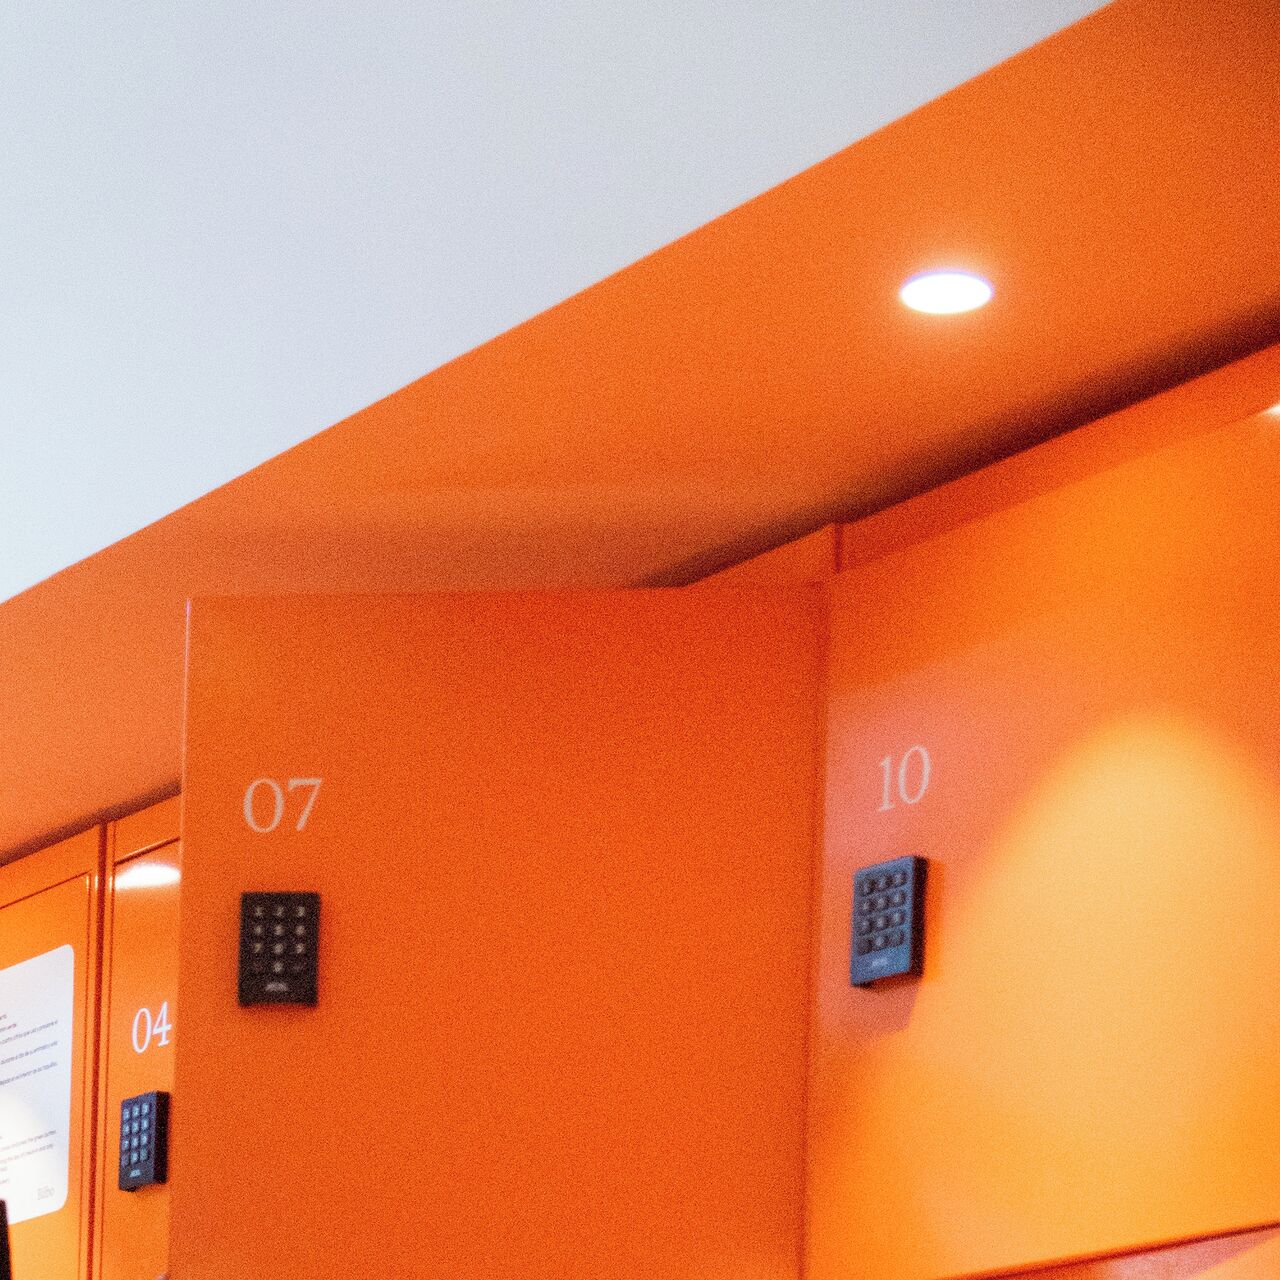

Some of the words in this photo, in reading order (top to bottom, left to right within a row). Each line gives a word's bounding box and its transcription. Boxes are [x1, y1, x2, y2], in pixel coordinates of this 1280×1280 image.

[243, 777, 322, 833] 07
[877, 744, 932, 812] 10
[131, 1001, 172, 1054] 04
